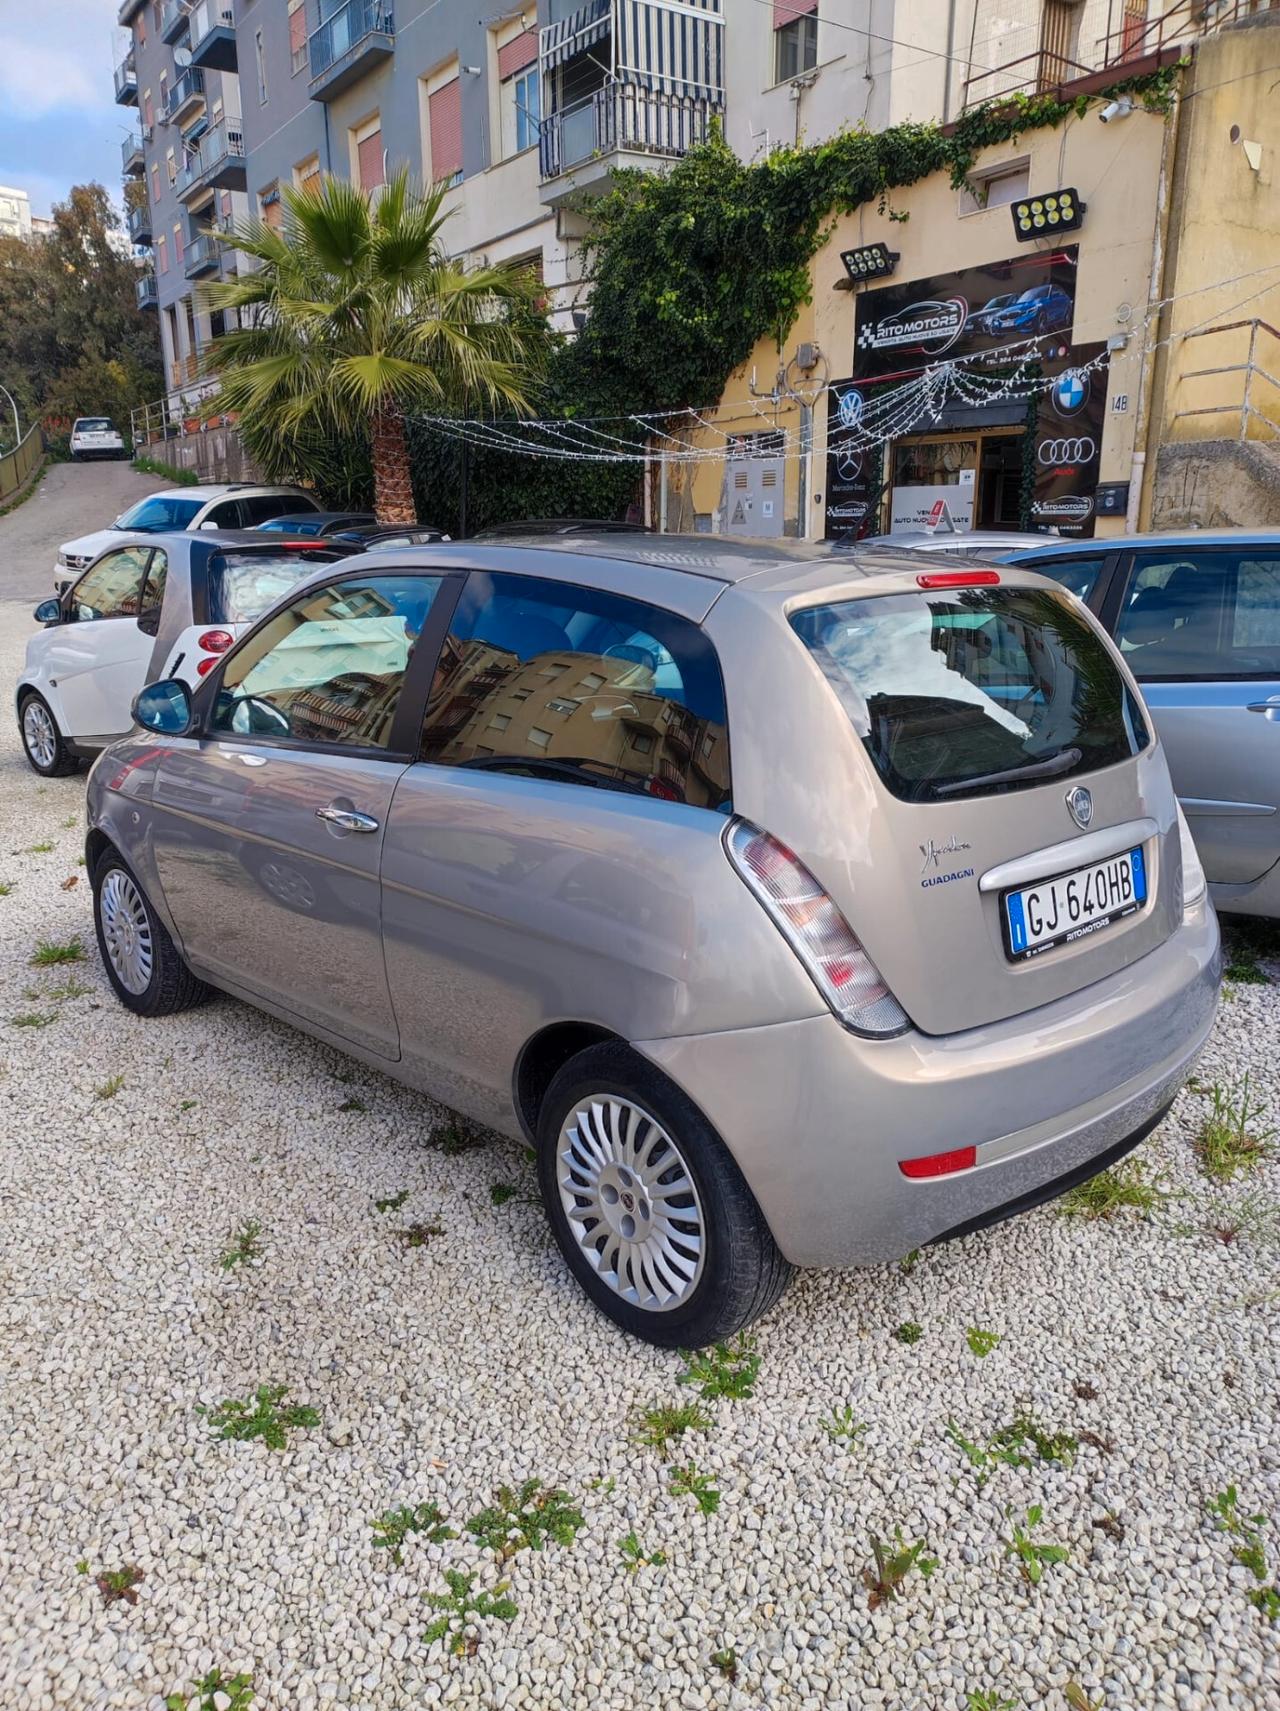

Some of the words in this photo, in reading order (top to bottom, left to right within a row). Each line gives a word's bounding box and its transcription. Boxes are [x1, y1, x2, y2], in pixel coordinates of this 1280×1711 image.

[876, 314, 958, 338] RITOMOTORS
[921, 868, 975, 888] GUADAGNI
[1027, 886, 1059, 936] GJ
[1066, 859, 1132, 921] 640HB
[1066, 917, 1110, 942] RITOMOTORS
